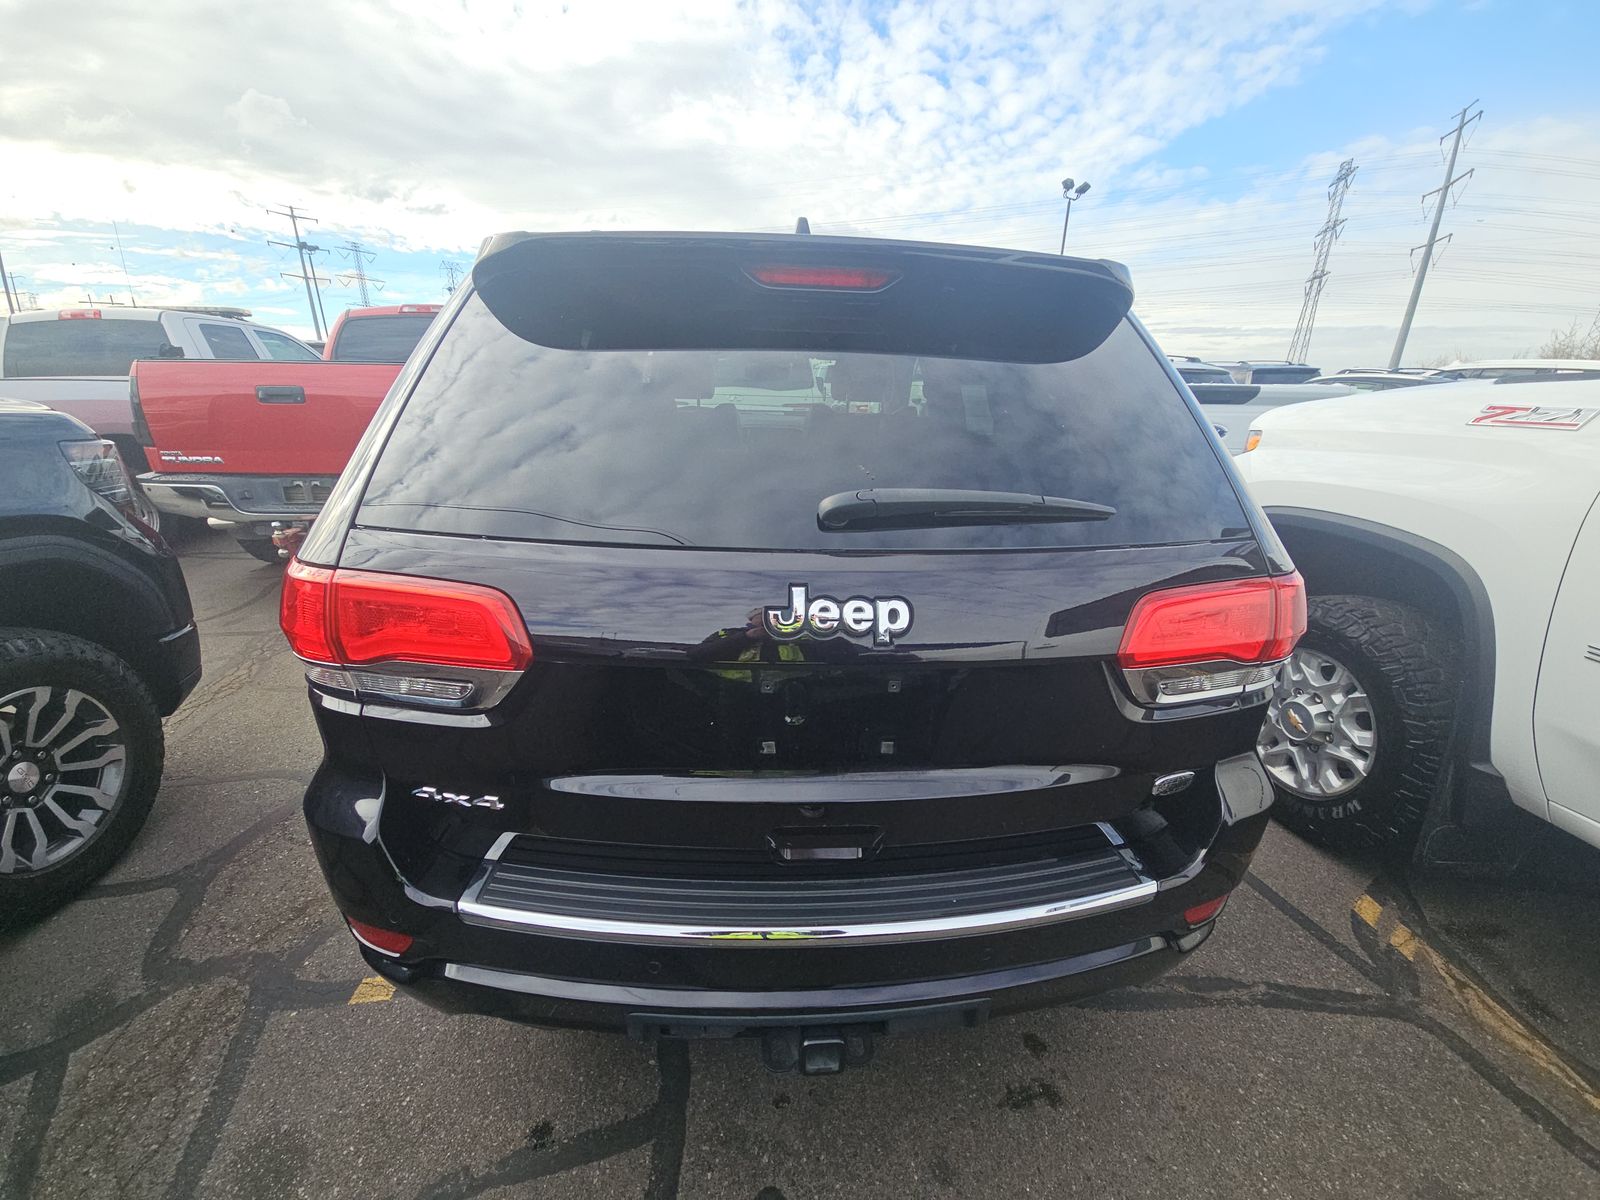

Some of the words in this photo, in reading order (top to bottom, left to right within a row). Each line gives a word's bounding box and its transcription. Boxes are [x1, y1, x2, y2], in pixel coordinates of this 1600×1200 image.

[1468, 404, 1598, 428] Z71
[161, 456, 224, 464] TUNDRA
[766, 584, 913, 645] Jeep
[17, 767, 35, 788] GMC
